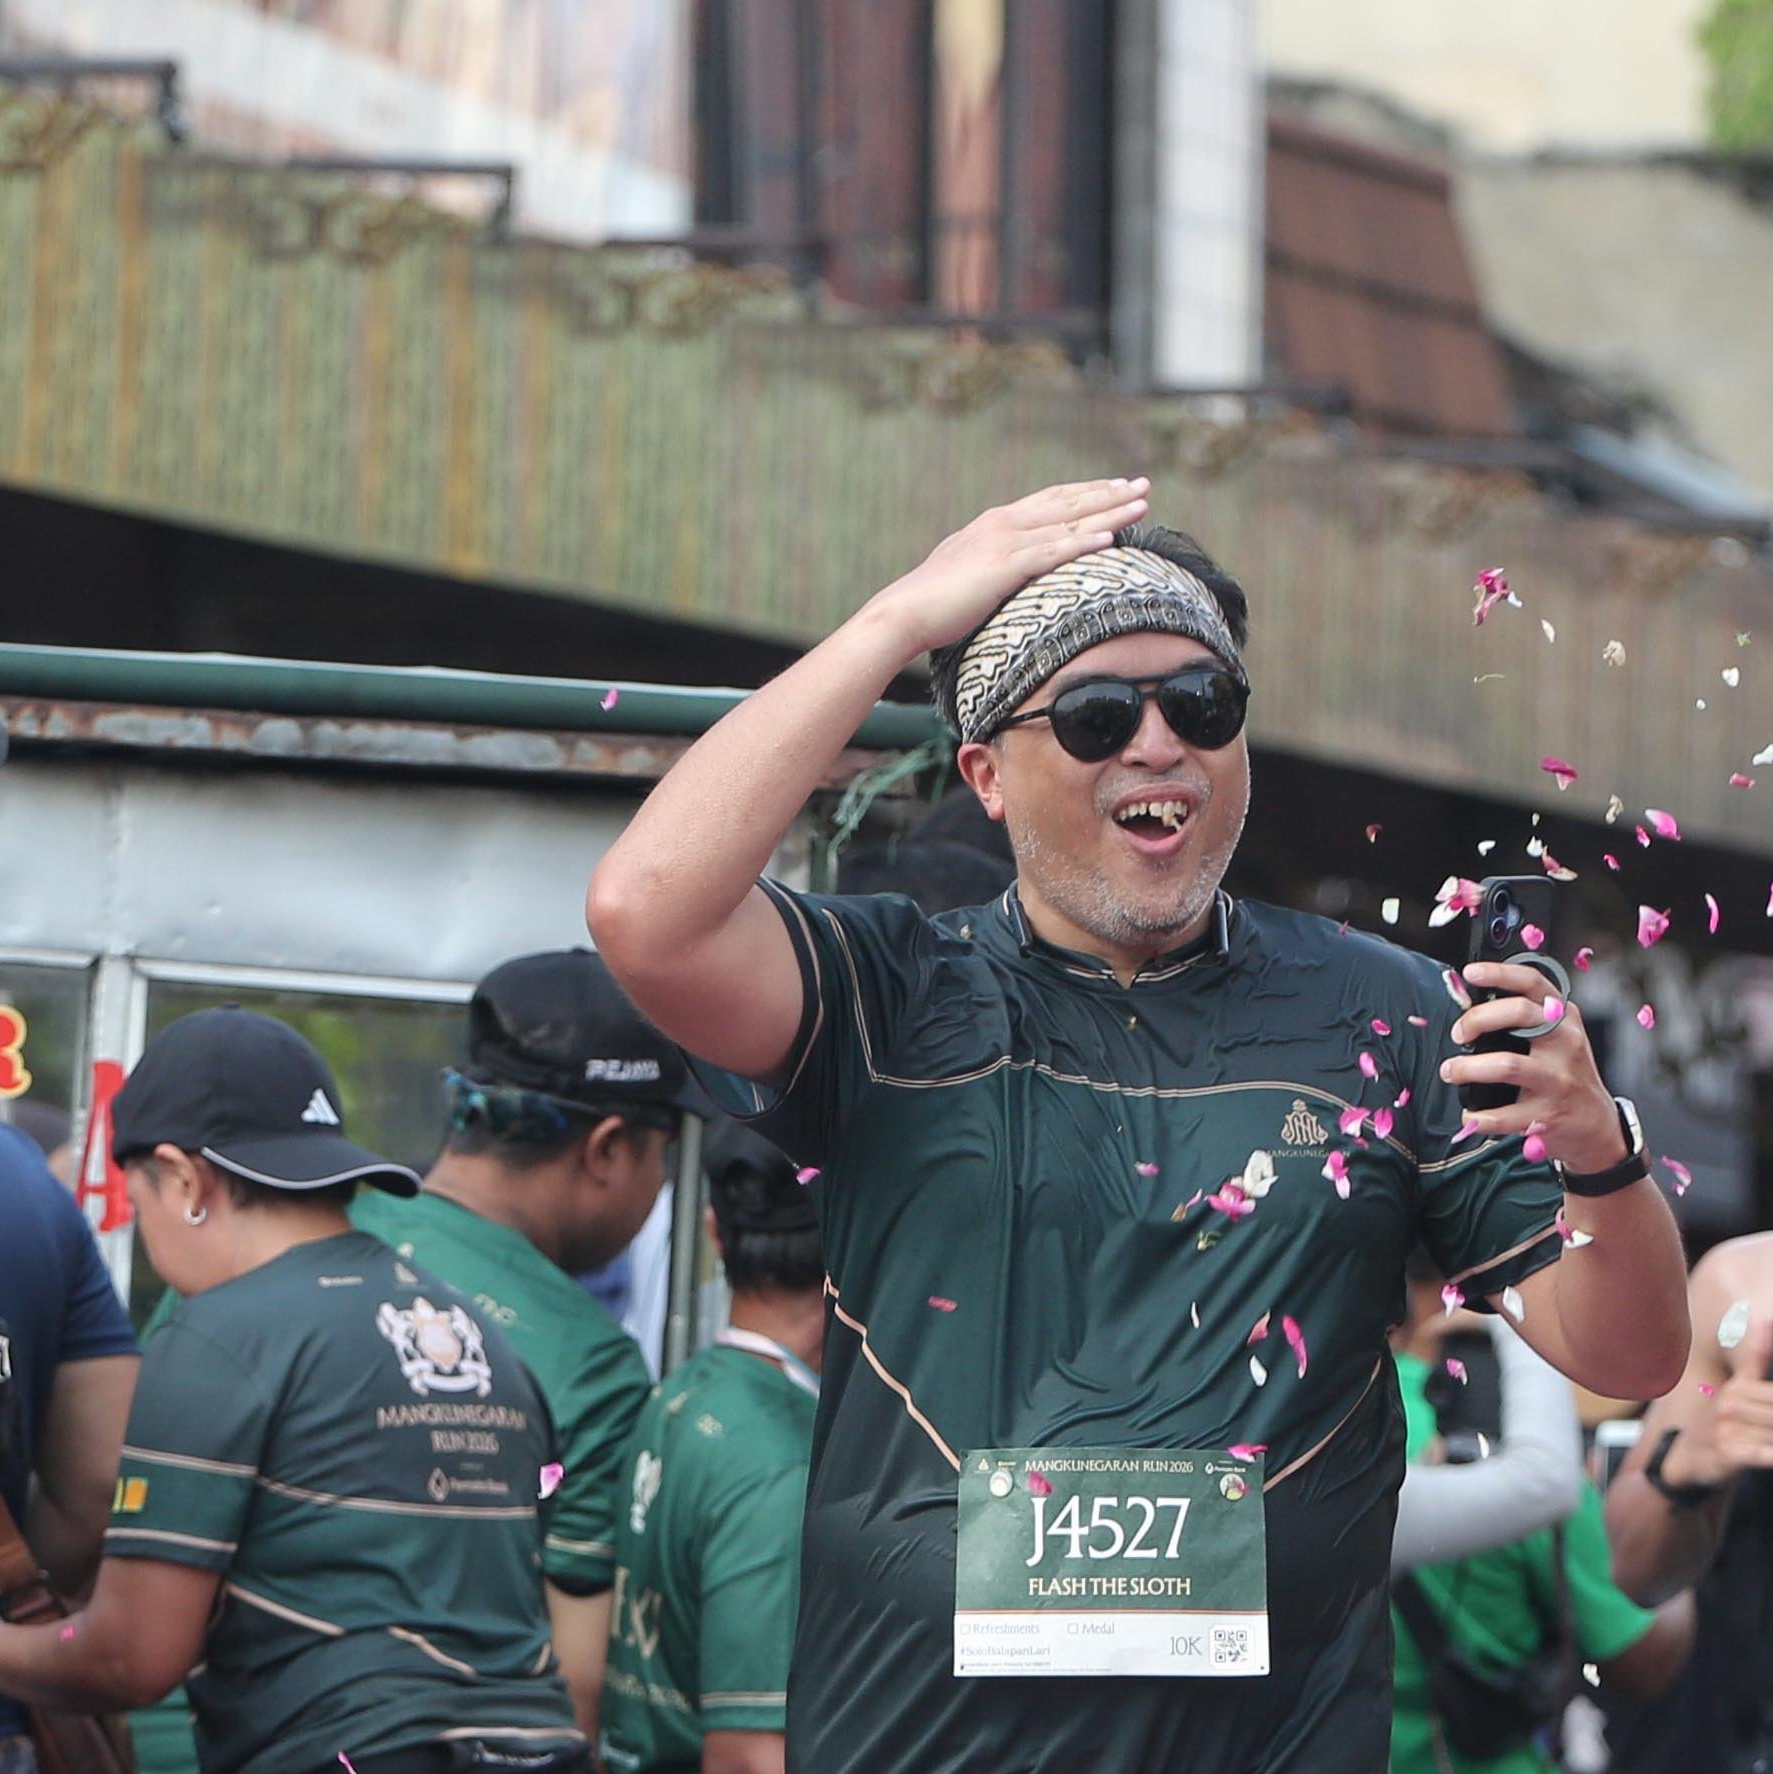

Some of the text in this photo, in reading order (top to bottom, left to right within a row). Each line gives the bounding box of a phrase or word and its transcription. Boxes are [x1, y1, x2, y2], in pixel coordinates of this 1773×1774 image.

[1266, 1148, 1350, 1159] ANGKUNEGN
[1025, 1460, 1139, 1473] MANGKUNEGARAN
[1143, 1461, 1168, 1472] RUN
[1169, 1461, 1194, 1473] 2026
[1026, 1495, 1191, 1567] J4527
[1029, 1577, 1192, 1596] FLASH THE SLOTH
[972, 1622, 1115, 1635] Refreshments Medal
[1170, 1636, 1203, 1656] 10K
